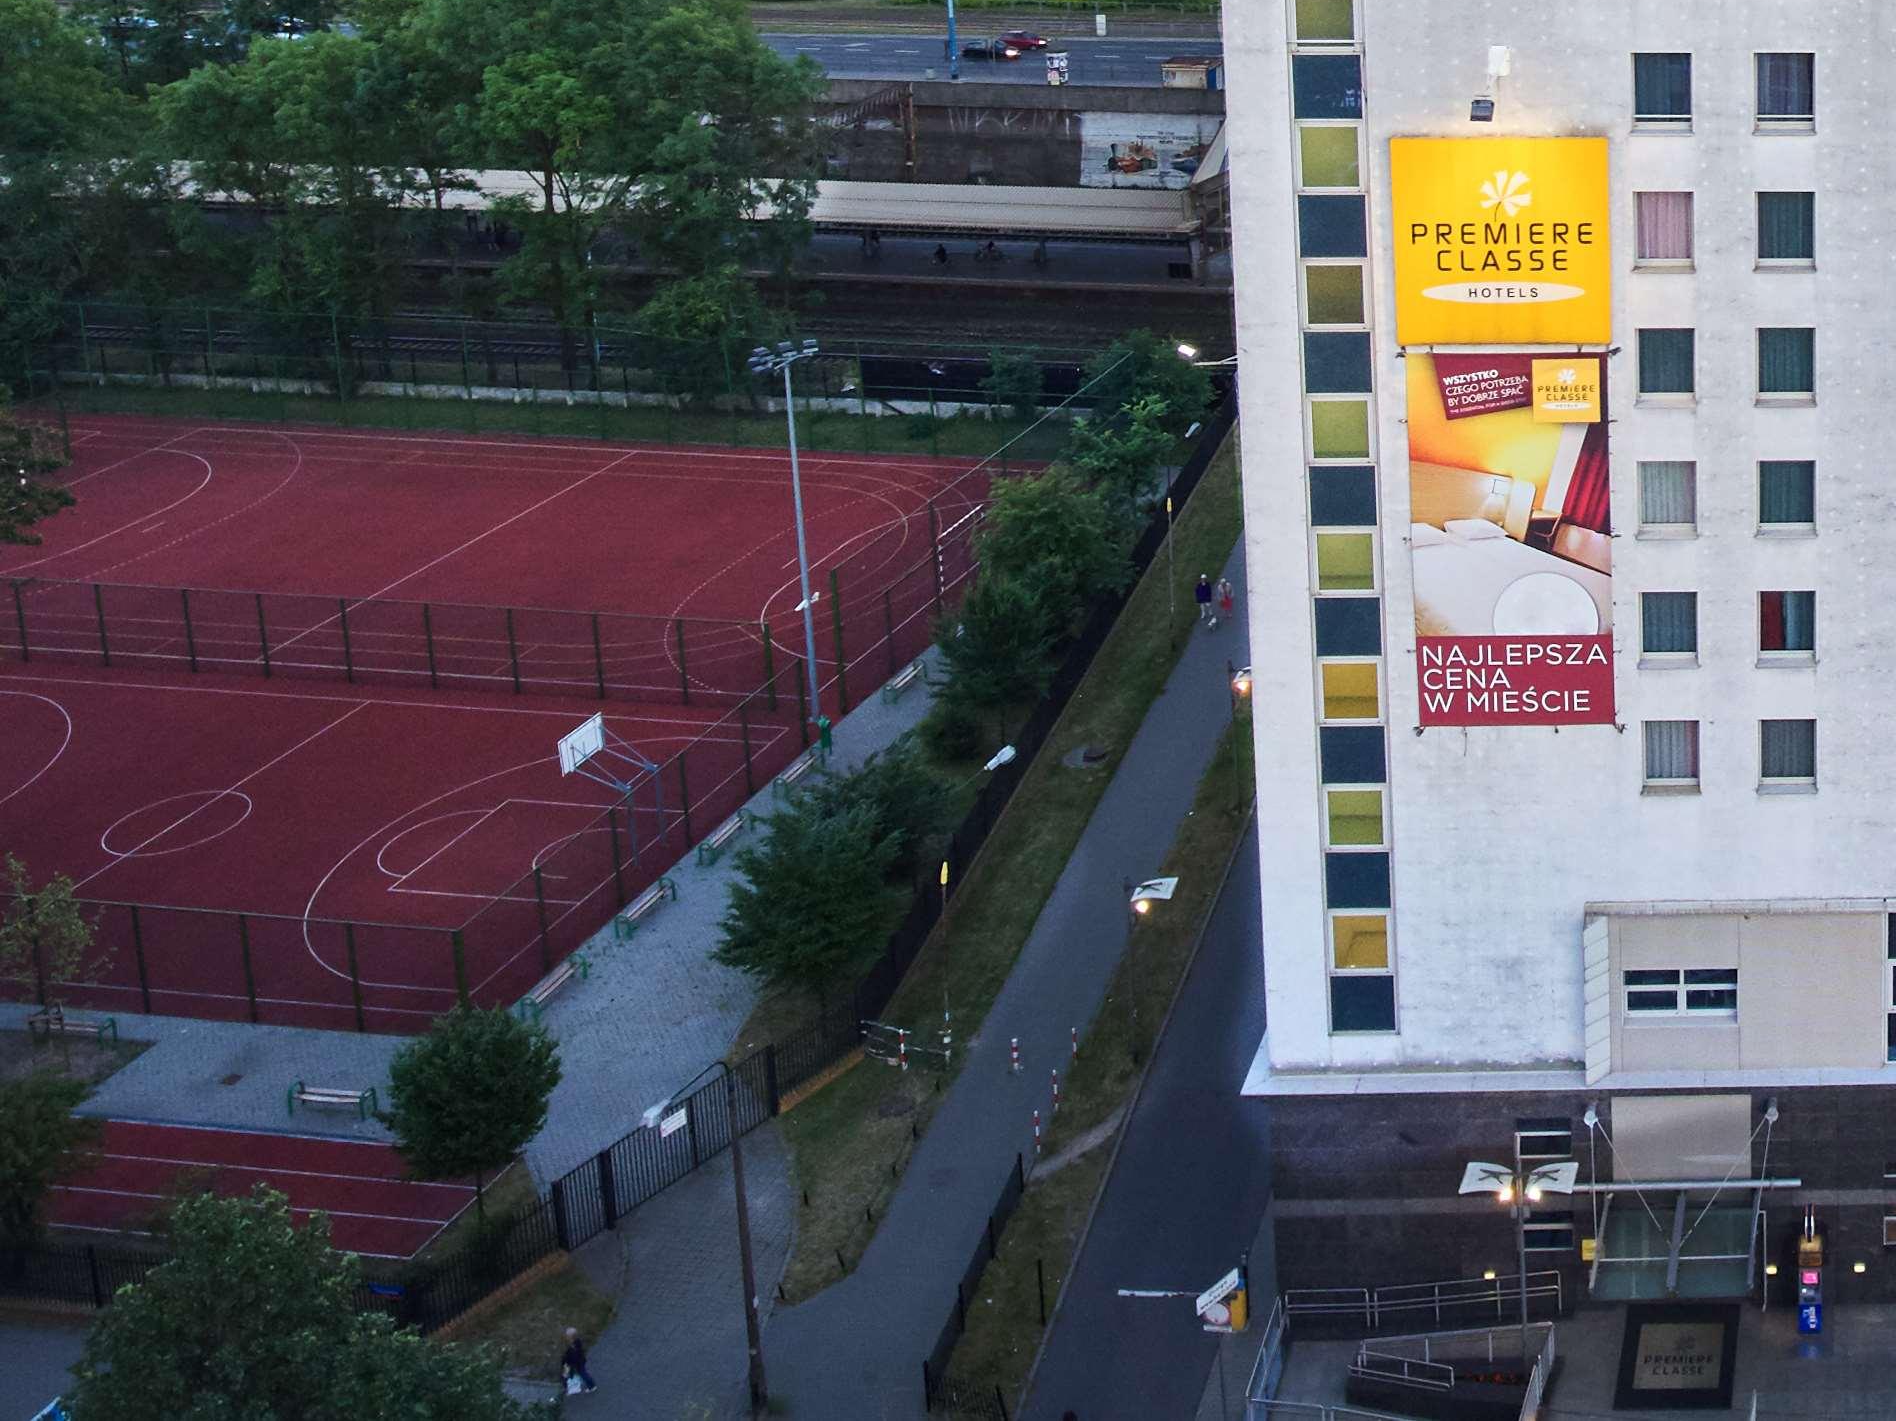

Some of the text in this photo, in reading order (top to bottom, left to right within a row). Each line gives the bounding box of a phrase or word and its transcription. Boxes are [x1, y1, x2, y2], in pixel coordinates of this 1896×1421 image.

[1412, 223, 1593, 245] PREMIERE
[1437, 250, 1568, 272] CLASSE
[1469, 287, 1539, 298] HOTELS
[1443, 369, 1499, 386] WSZYSTKO
[1445, 375, 1529, 396] CZEGO POTRZEBA
[1448, 397, 1460, 407] BY
[1462, 389, 1500, 404] DOBRZE
[1501, 384, 1524, 398] SPAĆ
[1537, 384, 1596, 393] PREMIERE
[1546, 393, 1589, 401] CLASSE
[1422, 643, 1608, 667] NAJLEPSZA
[1424, 668, 1511, 691] CENA
[1425, 685, 1591, 713] W MIEŚCIE
[1643, 1354, 1714, 1364] PREMIERE
[1652, 1365, 1705, 1375] CLASSE
